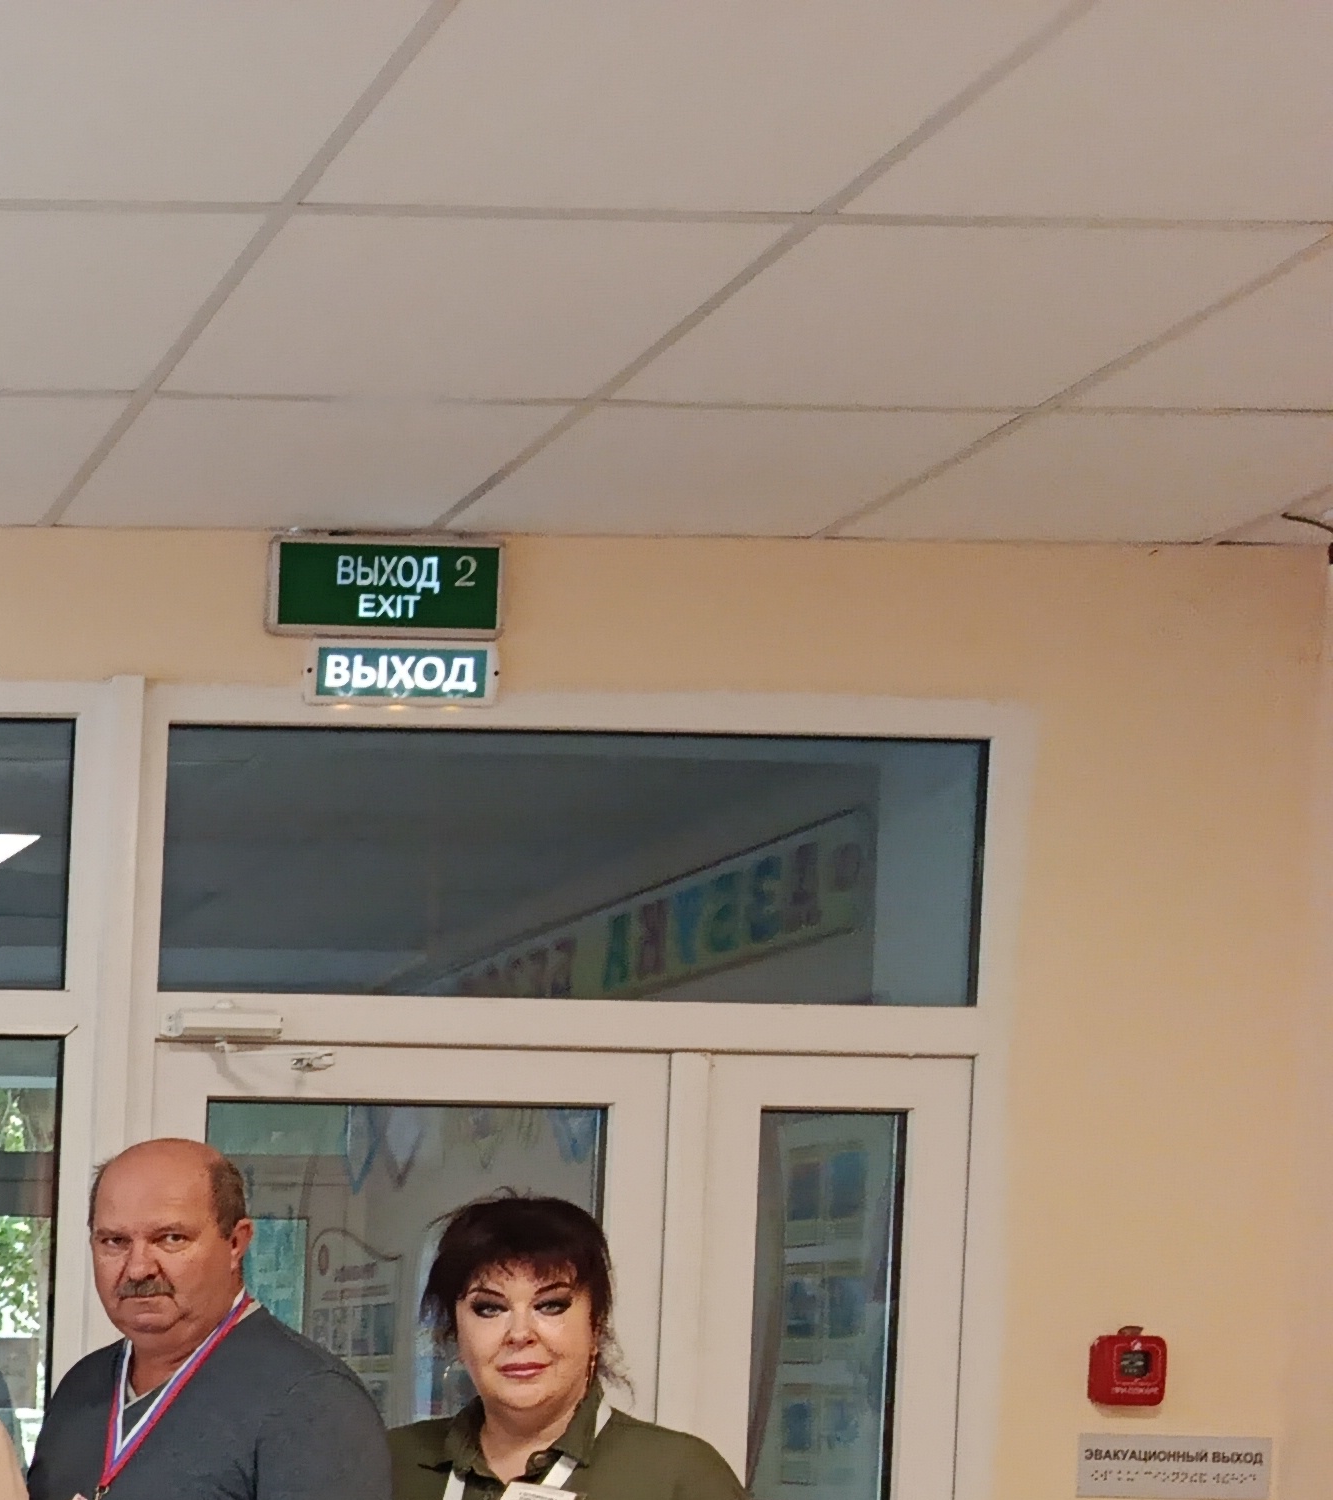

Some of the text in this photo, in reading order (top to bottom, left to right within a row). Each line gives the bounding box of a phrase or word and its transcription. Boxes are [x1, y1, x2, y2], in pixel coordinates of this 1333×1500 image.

[336, 555, 477, 594] ВЫХОД 2
[358, 594, 421, 618] EXIT
[325, 654, 477, 693] ВЫХОД
[1085, 1448, 1263, 1466] ЭВАКУАЦИОННЫЙ ВЫХОД
